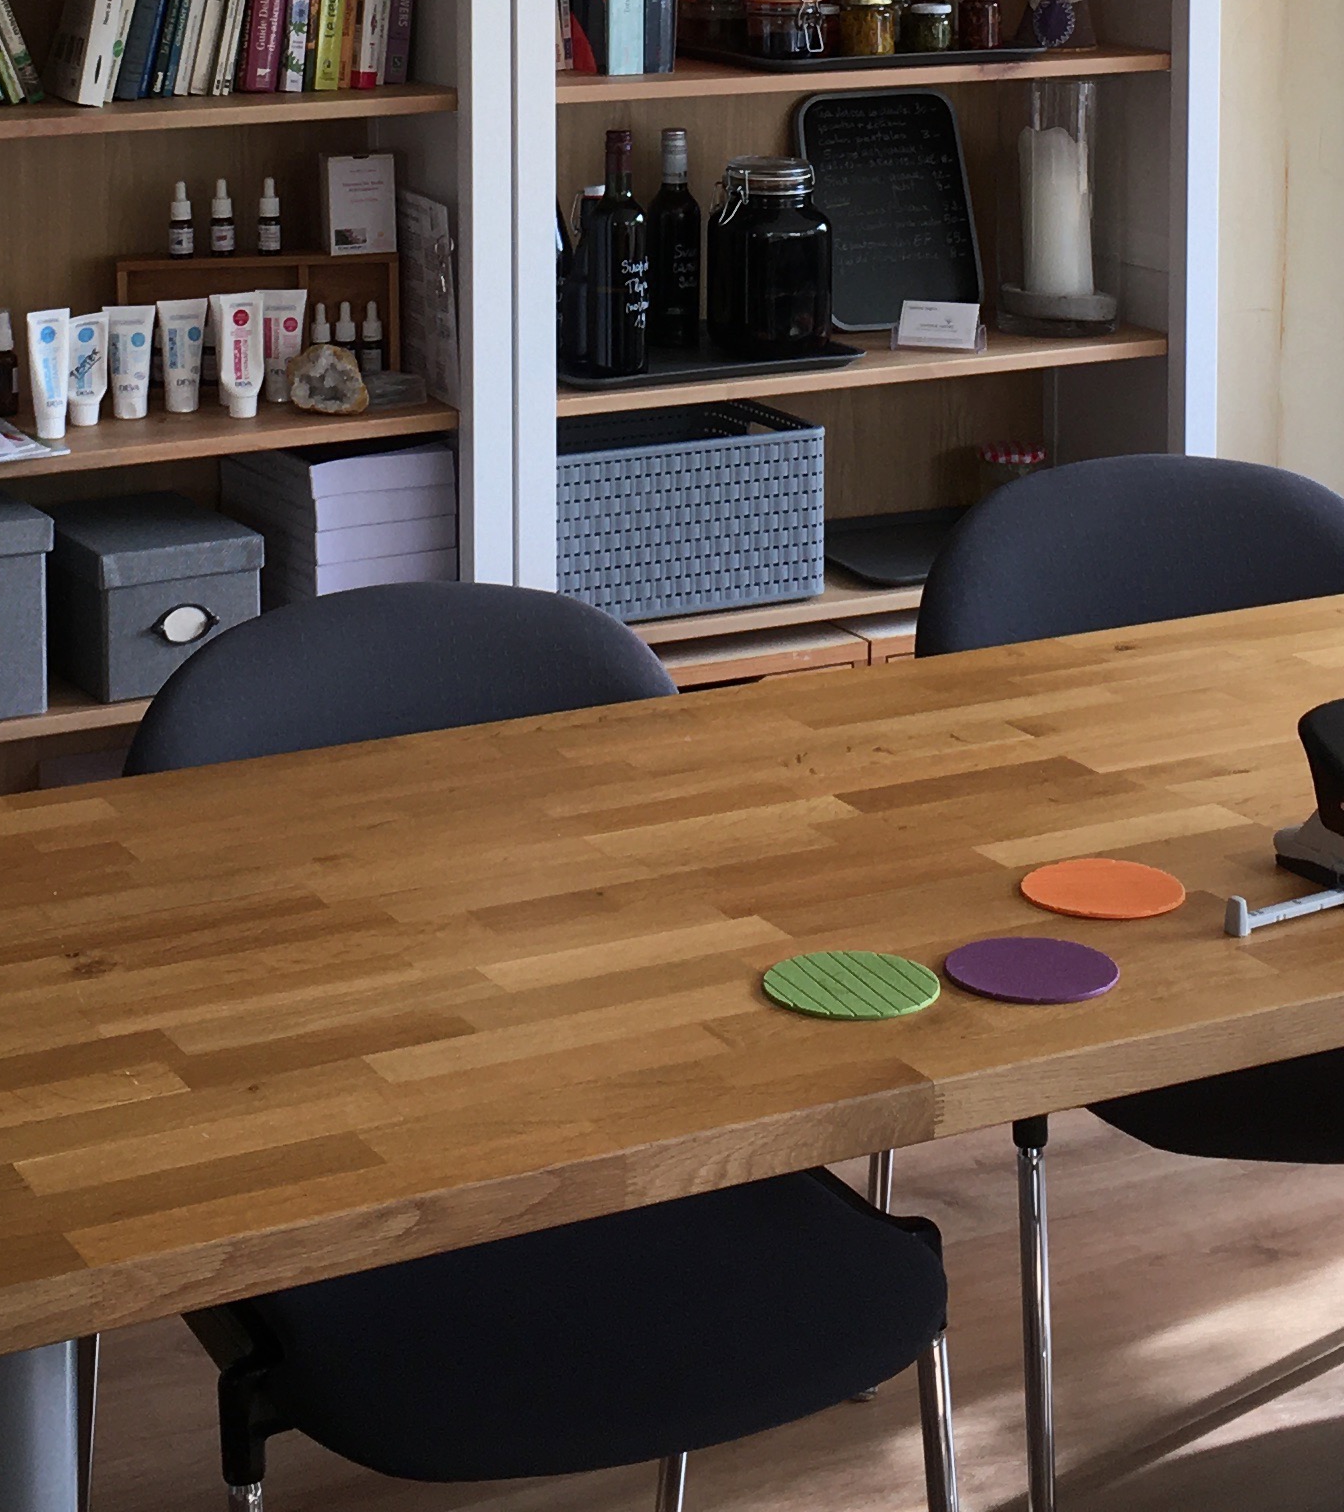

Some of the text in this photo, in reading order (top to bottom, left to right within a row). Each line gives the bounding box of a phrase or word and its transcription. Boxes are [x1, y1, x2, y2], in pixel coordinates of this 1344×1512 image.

[254, 19, 268, 51] Guide
[323, 20, 335, 38] Le
[119, 384, 139, 392] DEVA
[176, 379, 196, 387] DEVA
